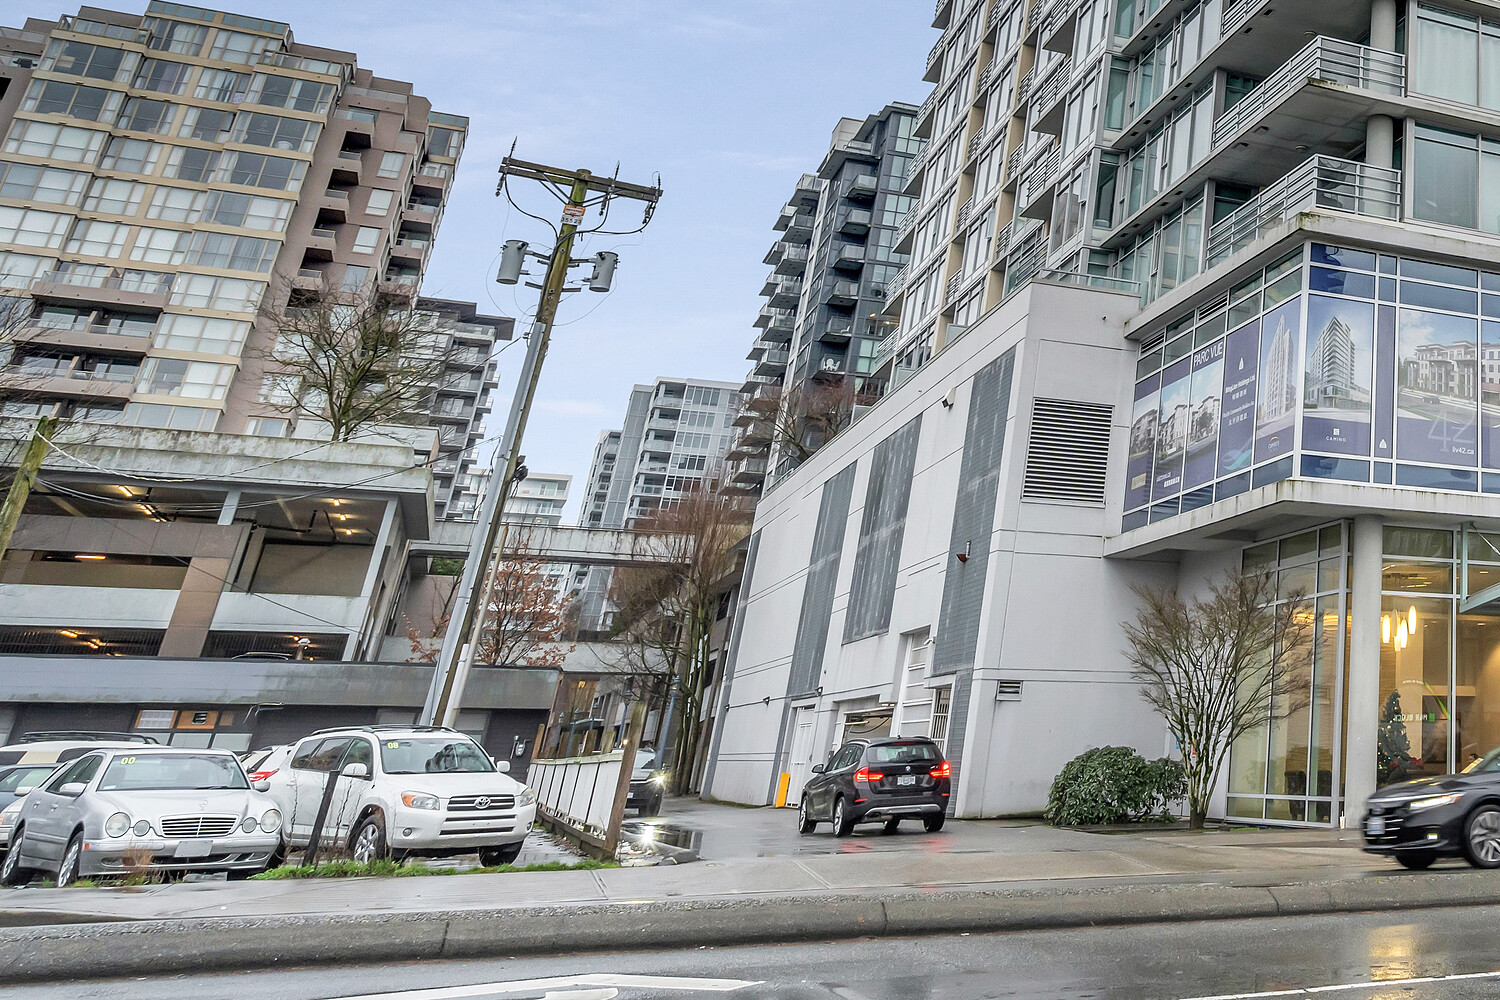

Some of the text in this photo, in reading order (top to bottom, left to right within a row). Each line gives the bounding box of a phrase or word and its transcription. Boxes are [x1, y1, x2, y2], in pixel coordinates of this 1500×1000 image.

[1194, 341, 1223, 368] PARC VUE
[1325, 435, 1347, 443] CAMINO
[1452, 446, 1475, 455] liv42.ca
